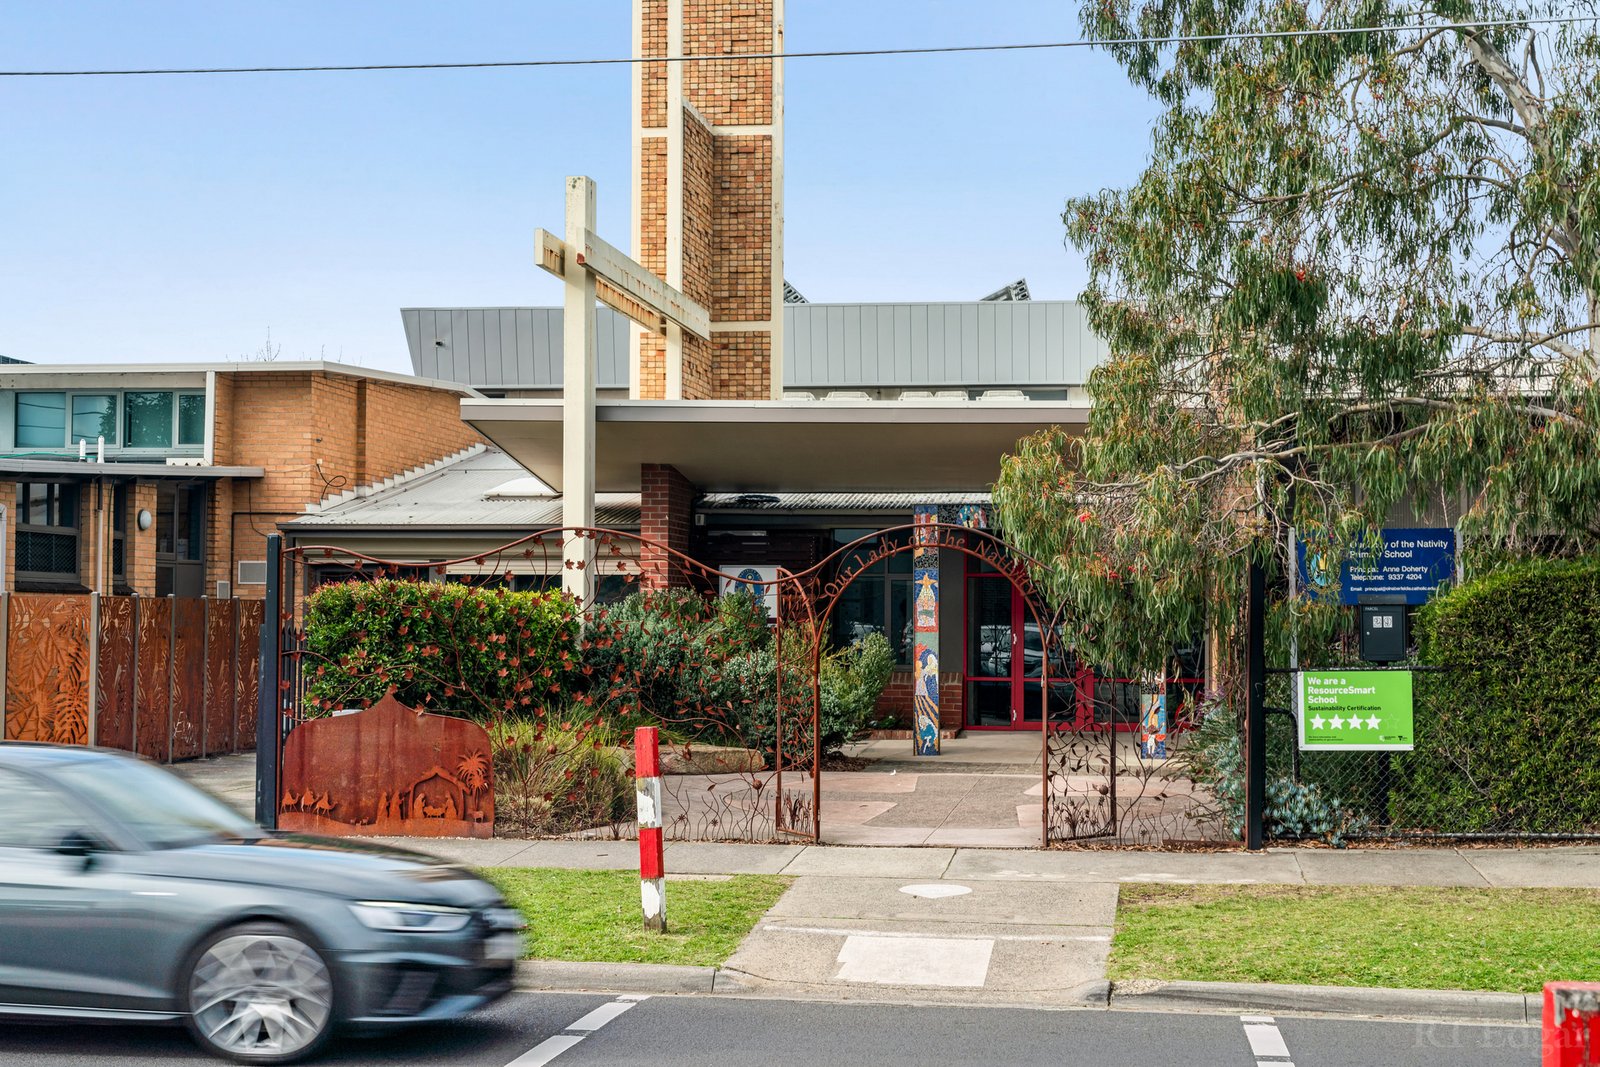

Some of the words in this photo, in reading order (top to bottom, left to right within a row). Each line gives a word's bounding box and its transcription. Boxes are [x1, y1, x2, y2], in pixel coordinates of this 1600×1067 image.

[1390, 540, 1400, 548] of
[1401, 540, 1415, 548] the
[1416, 539, 1448, 550] Nativity
[1349, 550, 1382, 560] Primy
[1384, 550, 1413, 558] School
[824, 566, 853, 597] Our
[853, 536, 898, 567] Lady
[908, 527, 925, 550] of
[932, 527, 966, 547] The
[974, 539, 1038, 595] Nativity
[1349, 565, 1379, 574] Princpa:
[1401, 565, 1429, 573] Doherty
[1307, 677, 1322, 685] We
[1307, 686, 1376, 695] ResourceSmart
[1307, 695, 1338, 704] School
